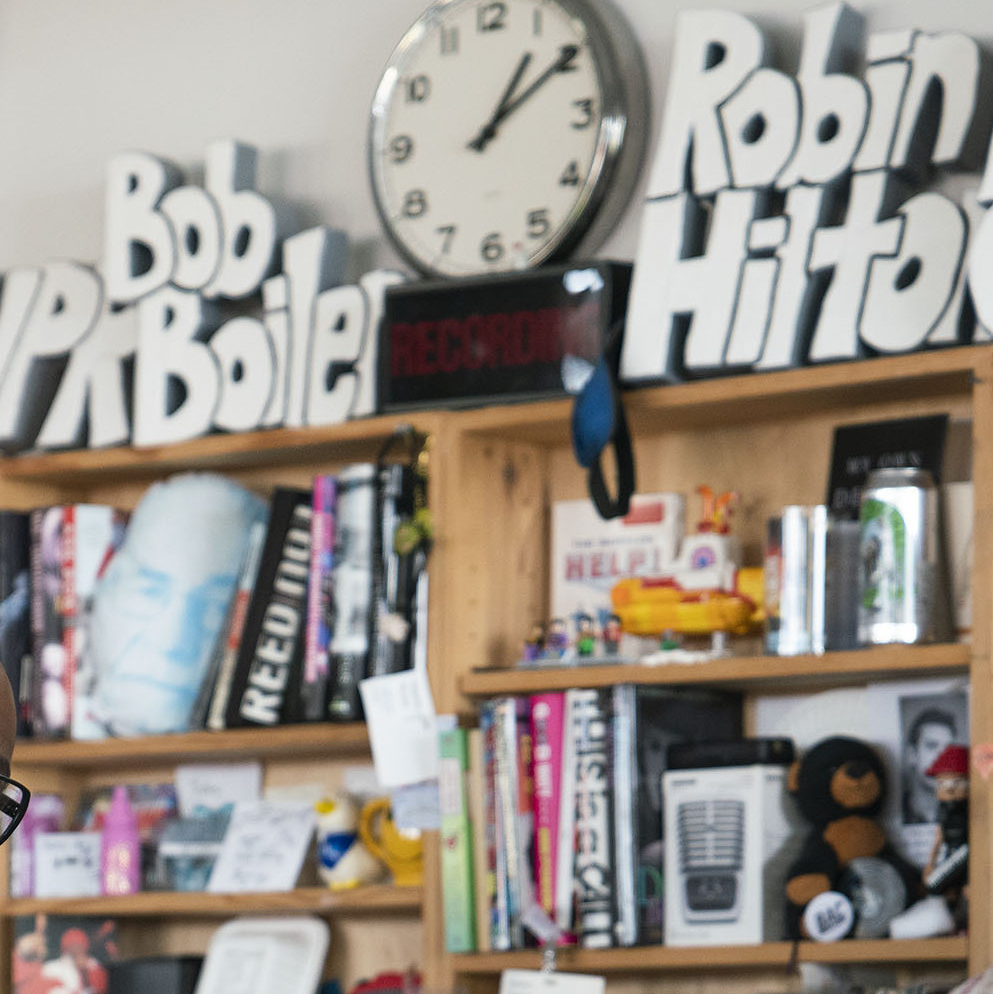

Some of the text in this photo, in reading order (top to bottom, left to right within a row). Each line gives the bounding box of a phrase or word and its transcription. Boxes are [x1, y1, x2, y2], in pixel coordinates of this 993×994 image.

[477, 2, 506, 32] 12
[440, 26, 460, 55] 11
[571, 98, 593, 130] 3
[646, 3, 981, 198] Robin
[390, 135, 413, 164] 9
[560, 160, 580, 188] 4
[403, 189, 428, 218] 8
[107, 139, 274, 301] Bob
[526, 208, 550, 239] 5
[436, 225, 456, 254] 7
[481, 232, 504, 262] 6
[619, 168, 984, 381] Hilto
[390, 303, 602, 377] RECORDI
[565, 549, 661, 581] HELP!
[239, 603, 299, 726] REED
